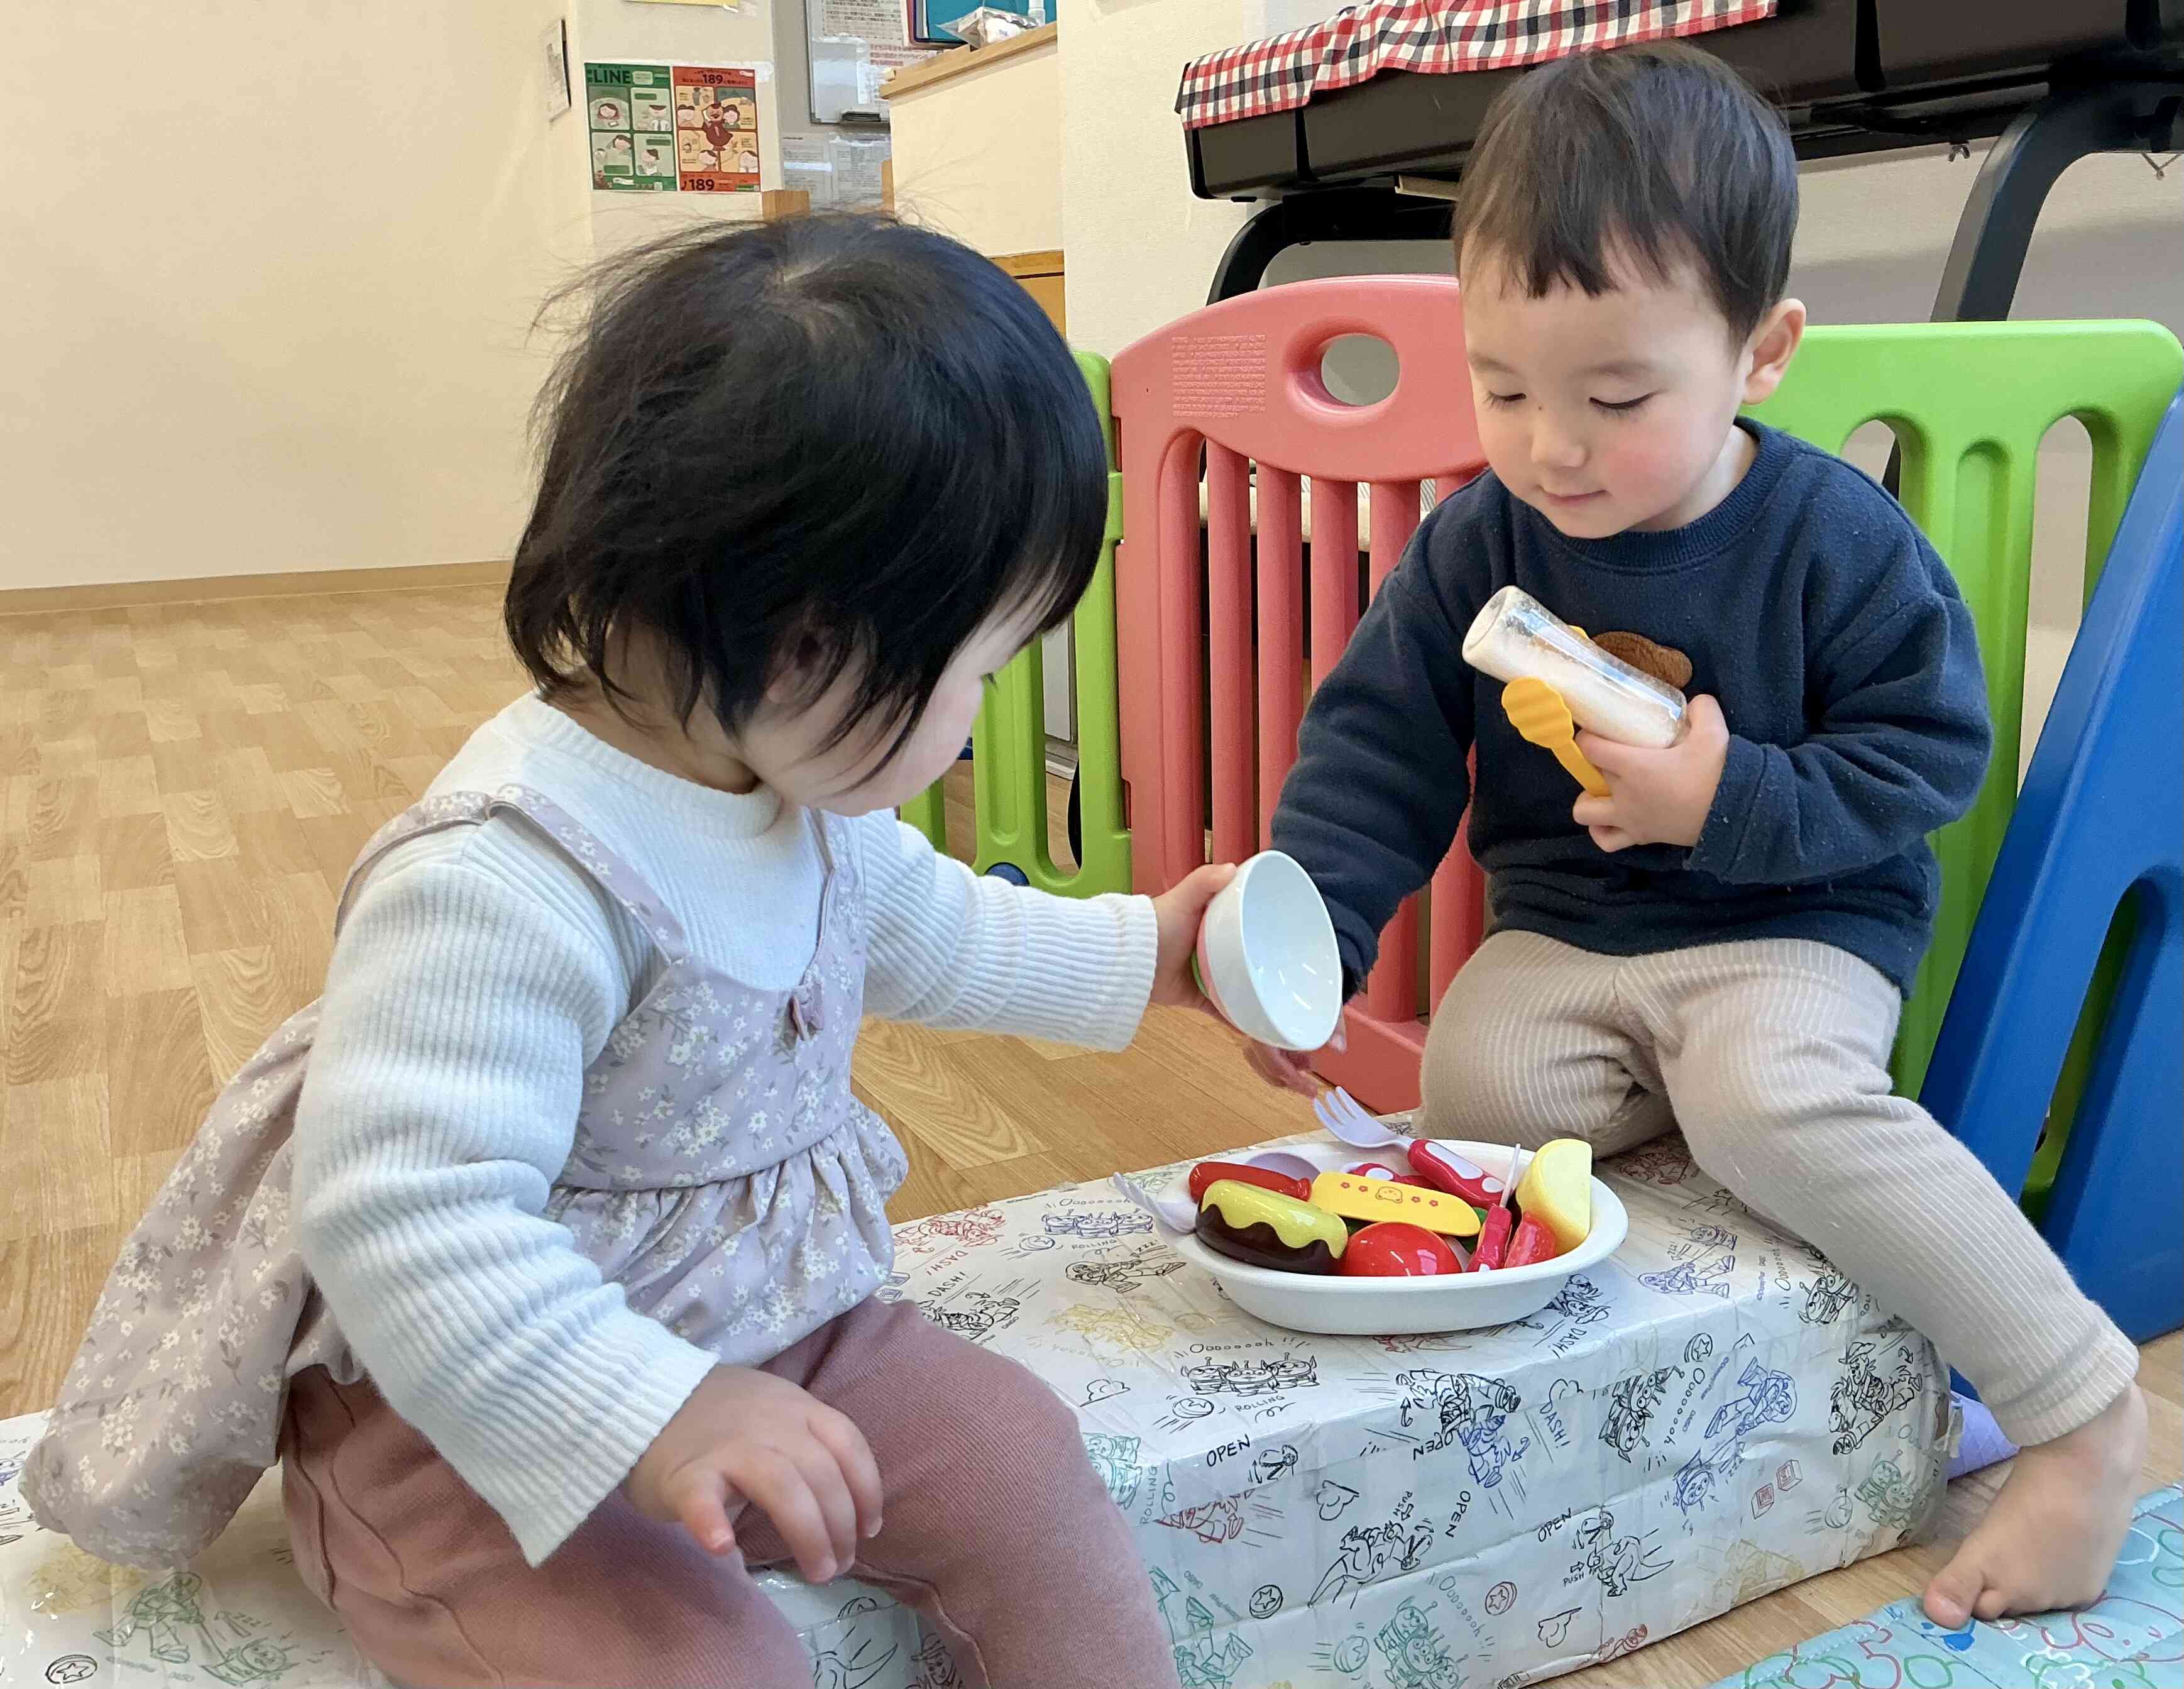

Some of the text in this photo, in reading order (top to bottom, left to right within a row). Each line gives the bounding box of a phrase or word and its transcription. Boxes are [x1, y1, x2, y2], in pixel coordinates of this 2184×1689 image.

[593, 69, 631, 84] LINE
[702, 74, 723, 84] 189
[688, 179, 715, 190] 189
[1071, 1238, 1117, 1250] ROLLING
[925, 1250, 969, 1276] DASH!
[928, 1271, 969, 1297] DASH!
[1548, 1328, 1588, 1359] DASH!
[1234, 1395, 1285, 1412] ROLLING
[1206, 1433, 1251, 1467] OPEN
[1139, 1466, 1158, 1524] ROLLING
[1393, 1490, 1413, 1516] PUSH
[1445, 1490, 1471, 1538] OPEN
[1538, 1507, 1572, 1543] OPEN
[1562, 1572, 1584, 1587] PUSH
